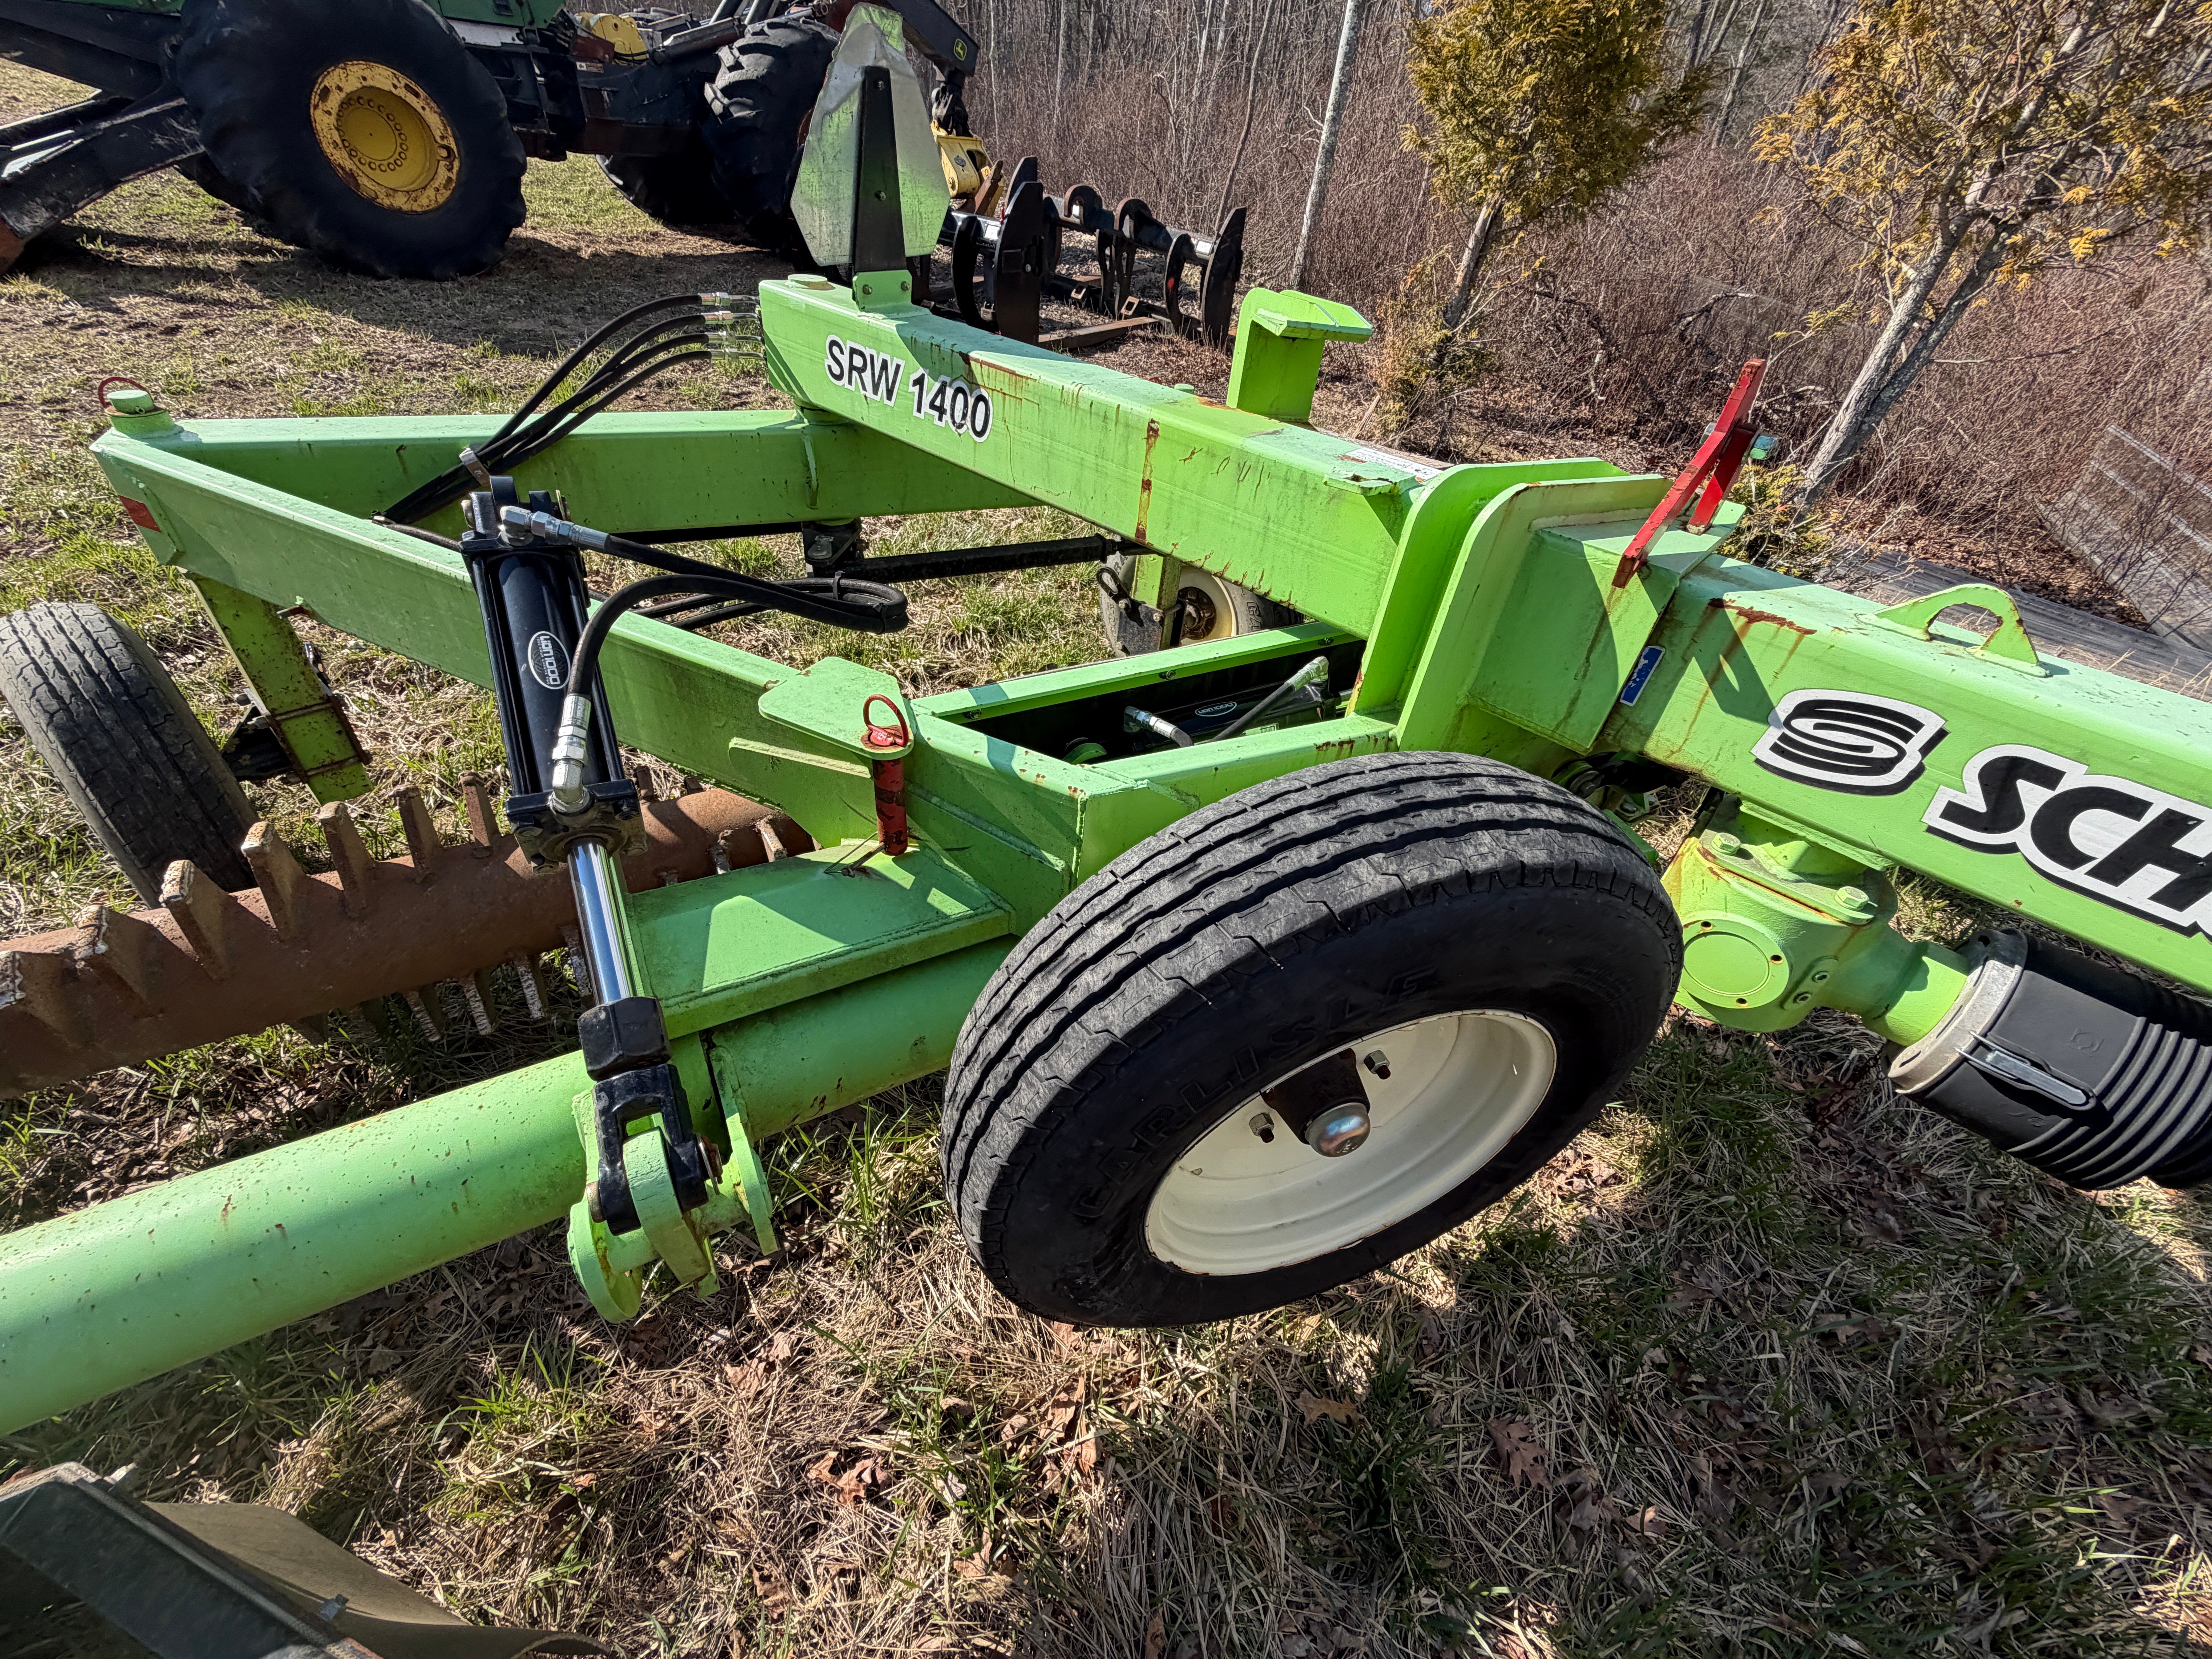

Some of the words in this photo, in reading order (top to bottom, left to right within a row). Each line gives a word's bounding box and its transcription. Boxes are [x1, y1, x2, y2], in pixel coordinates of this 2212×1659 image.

[827, 339, 901, 402] SRW
[912, 373, 990, 438] 1400
[1939, 755, 2212, 912] SCH
